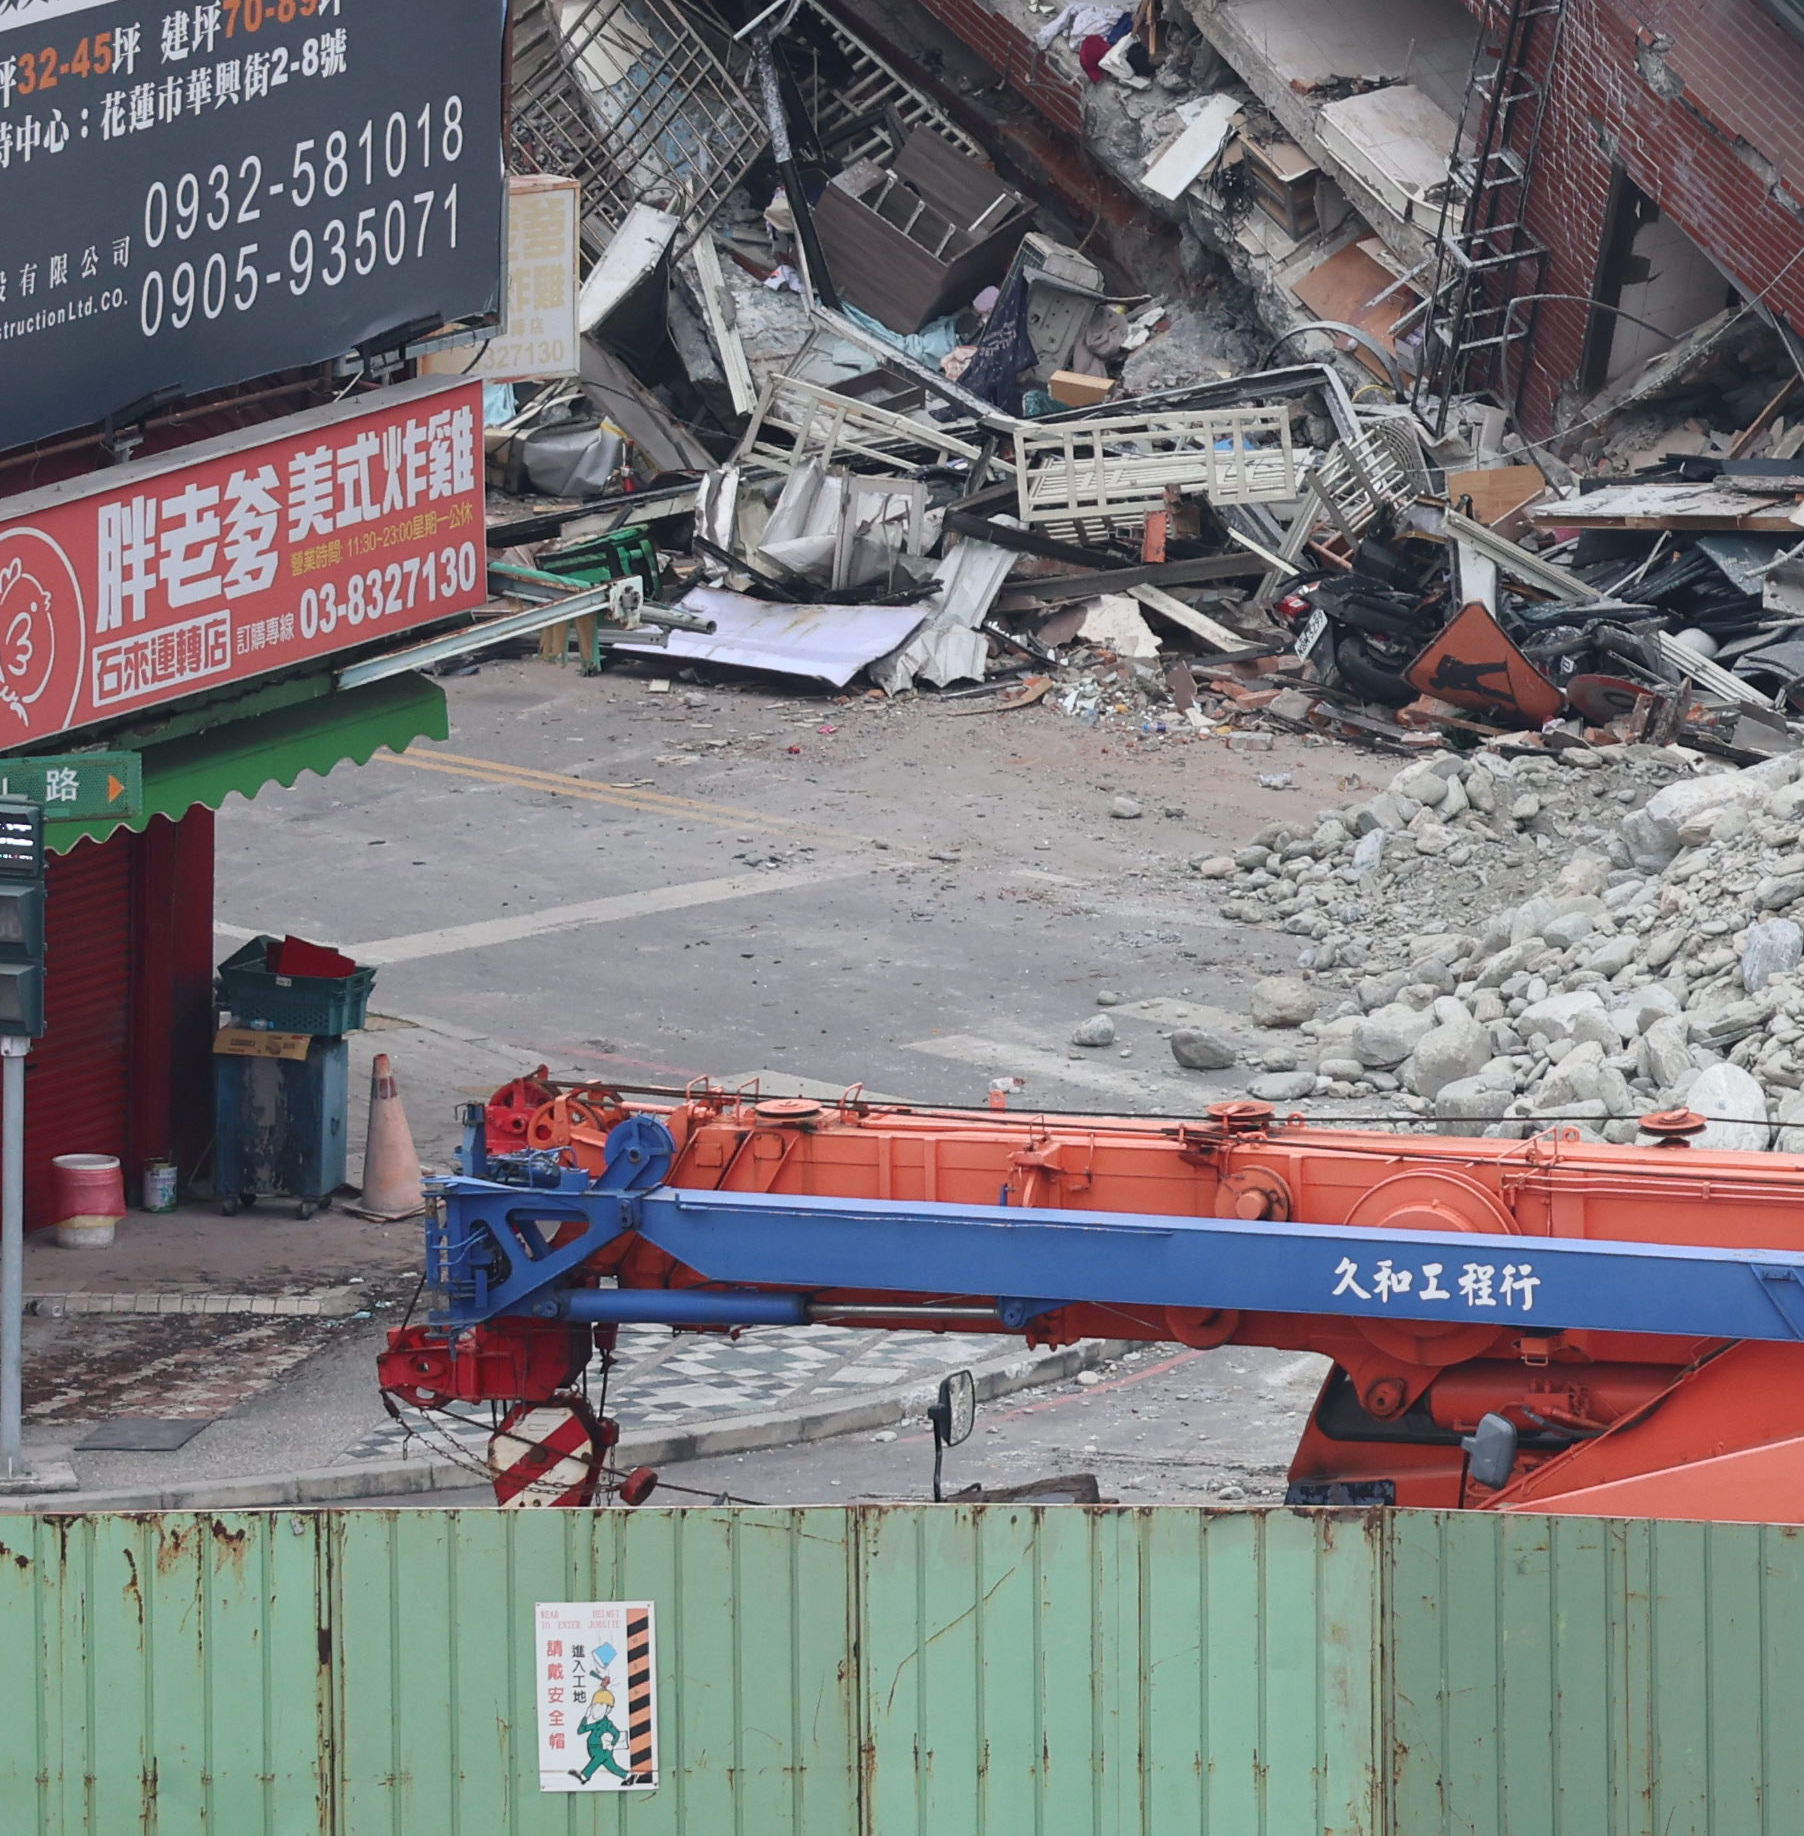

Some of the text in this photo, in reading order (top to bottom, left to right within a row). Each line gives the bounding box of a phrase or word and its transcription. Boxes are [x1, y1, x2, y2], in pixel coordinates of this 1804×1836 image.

[143, 94, 465, 249] 0932-581018
[139, 183, 459, 338] 0905-935071
[95, 405, 475, 635] 胖老爹 美式炸雞
[236, 540, 477, 656] 訂購專線 03-8327130
[95, 613, 230, 697] 石來運轉店
[2, 767, 80, 802] 路
[1331, 1256, 1542, 1312] 久和工程行
[546, 1639, 566, 1750] 請戴安全帽
[571, 1644, 587, 1704] 進入工地
